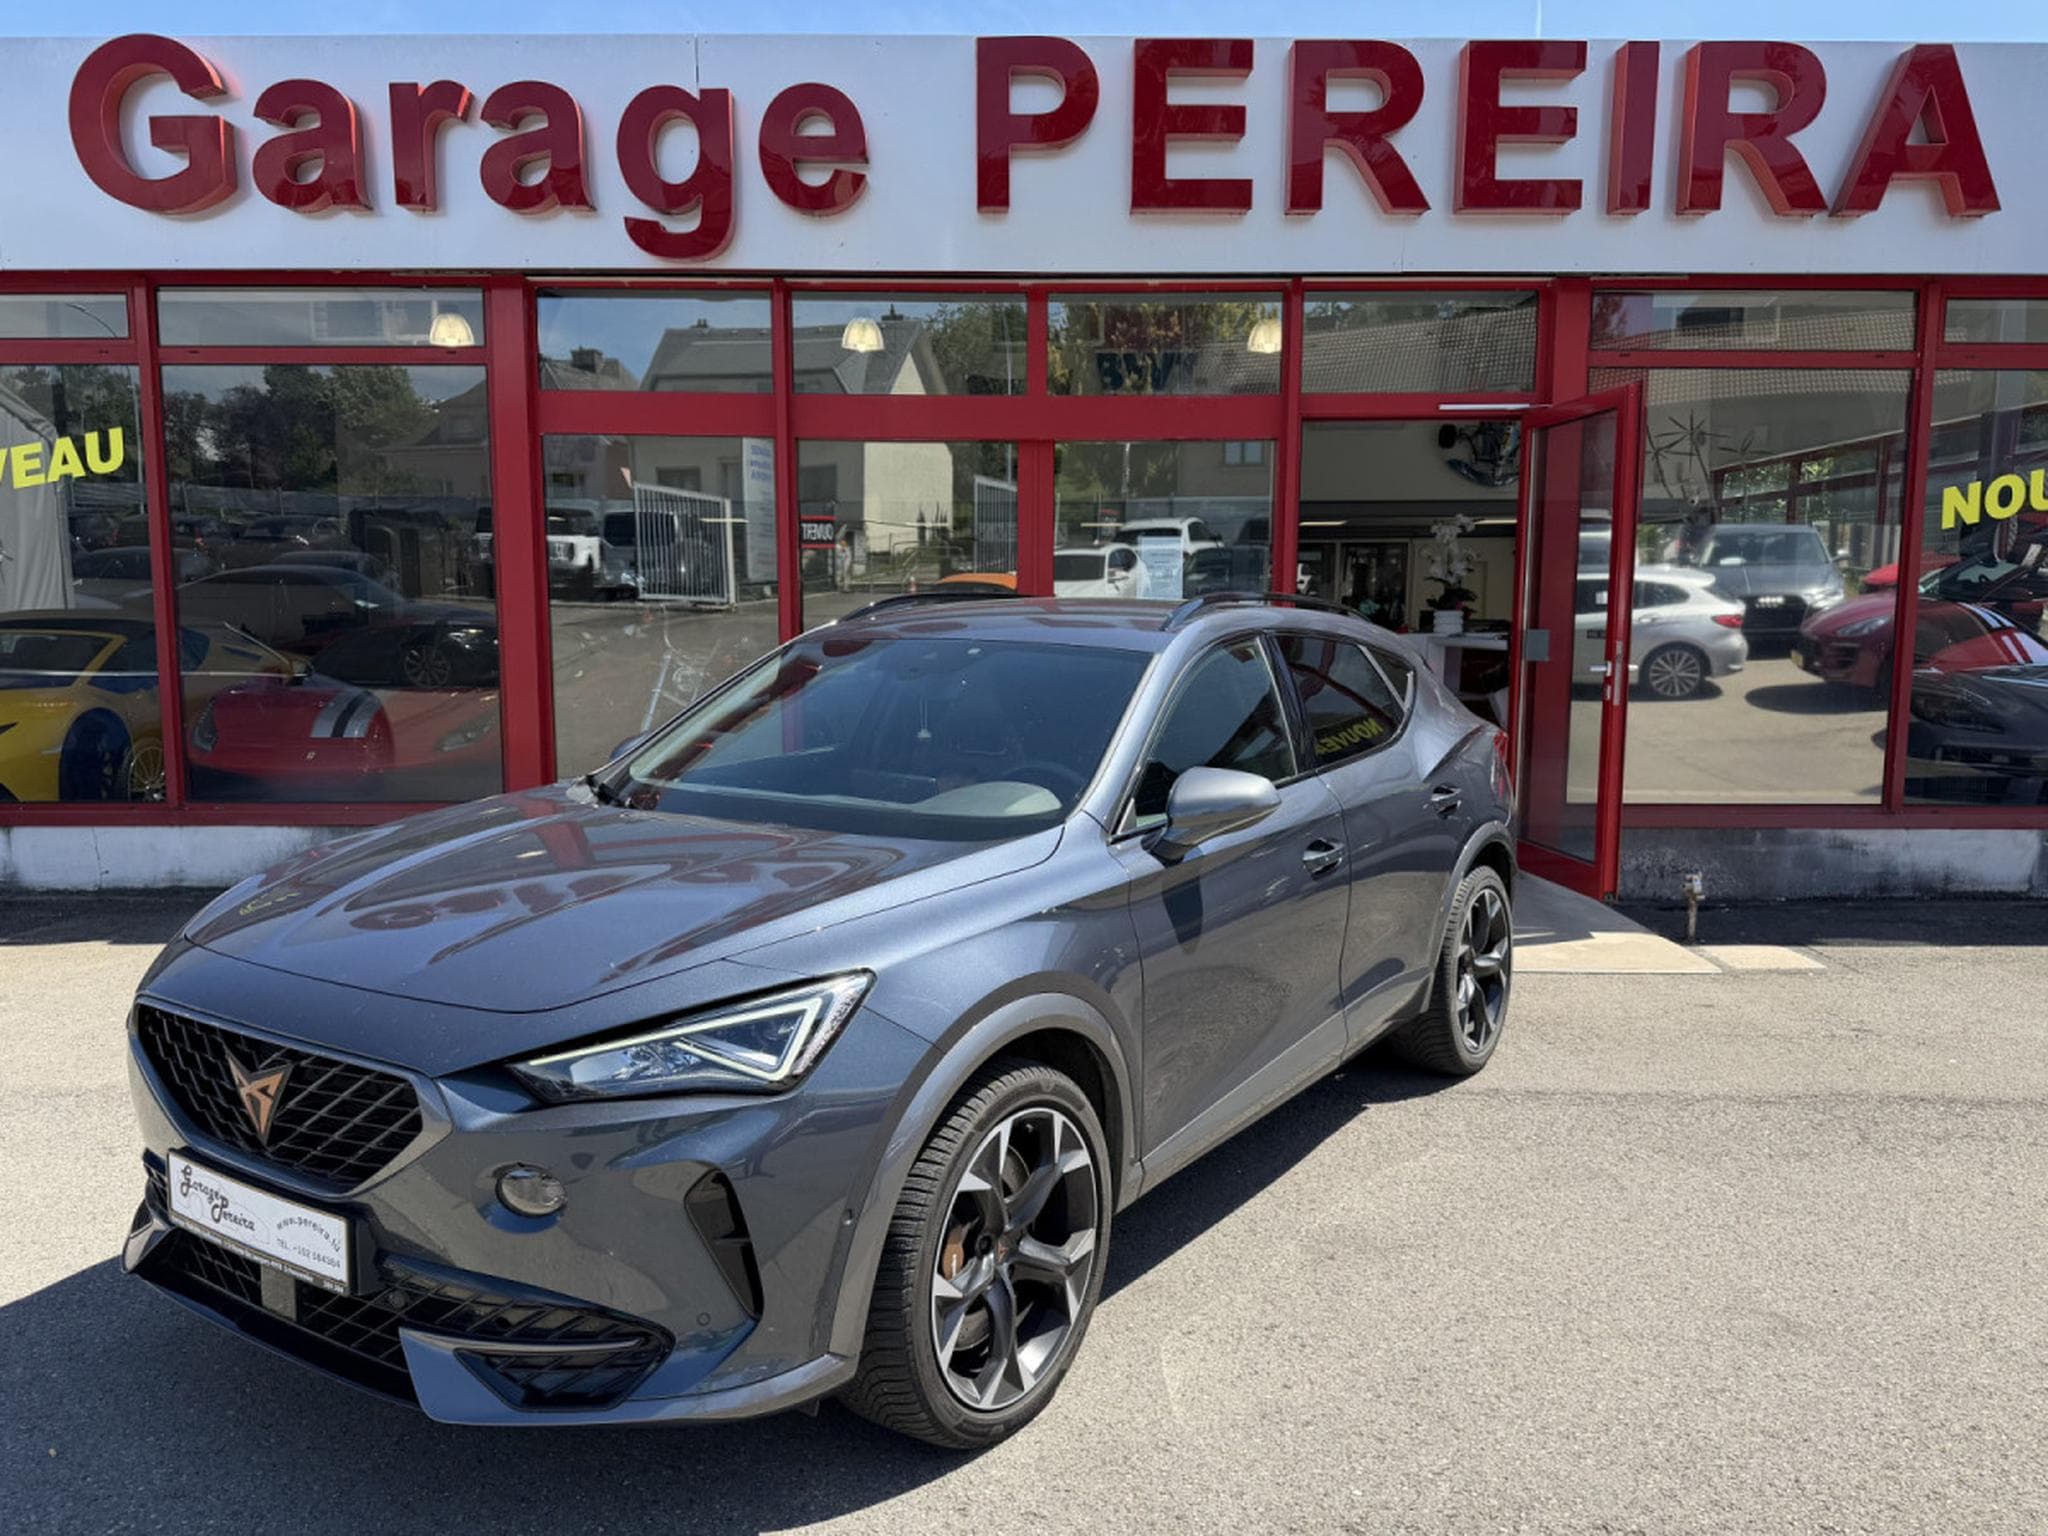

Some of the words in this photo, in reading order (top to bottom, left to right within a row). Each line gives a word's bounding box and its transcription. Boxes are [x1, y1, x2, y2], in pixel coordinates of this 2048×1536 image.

[68, 33, 869, 260] Garage
[975, 36, 2001, 218] PEREIRA
[0, 426, 124, 489] EAU
[180, 1164, 219, 1206] Garage
[211, 1193, 256, 1231] Pereira
